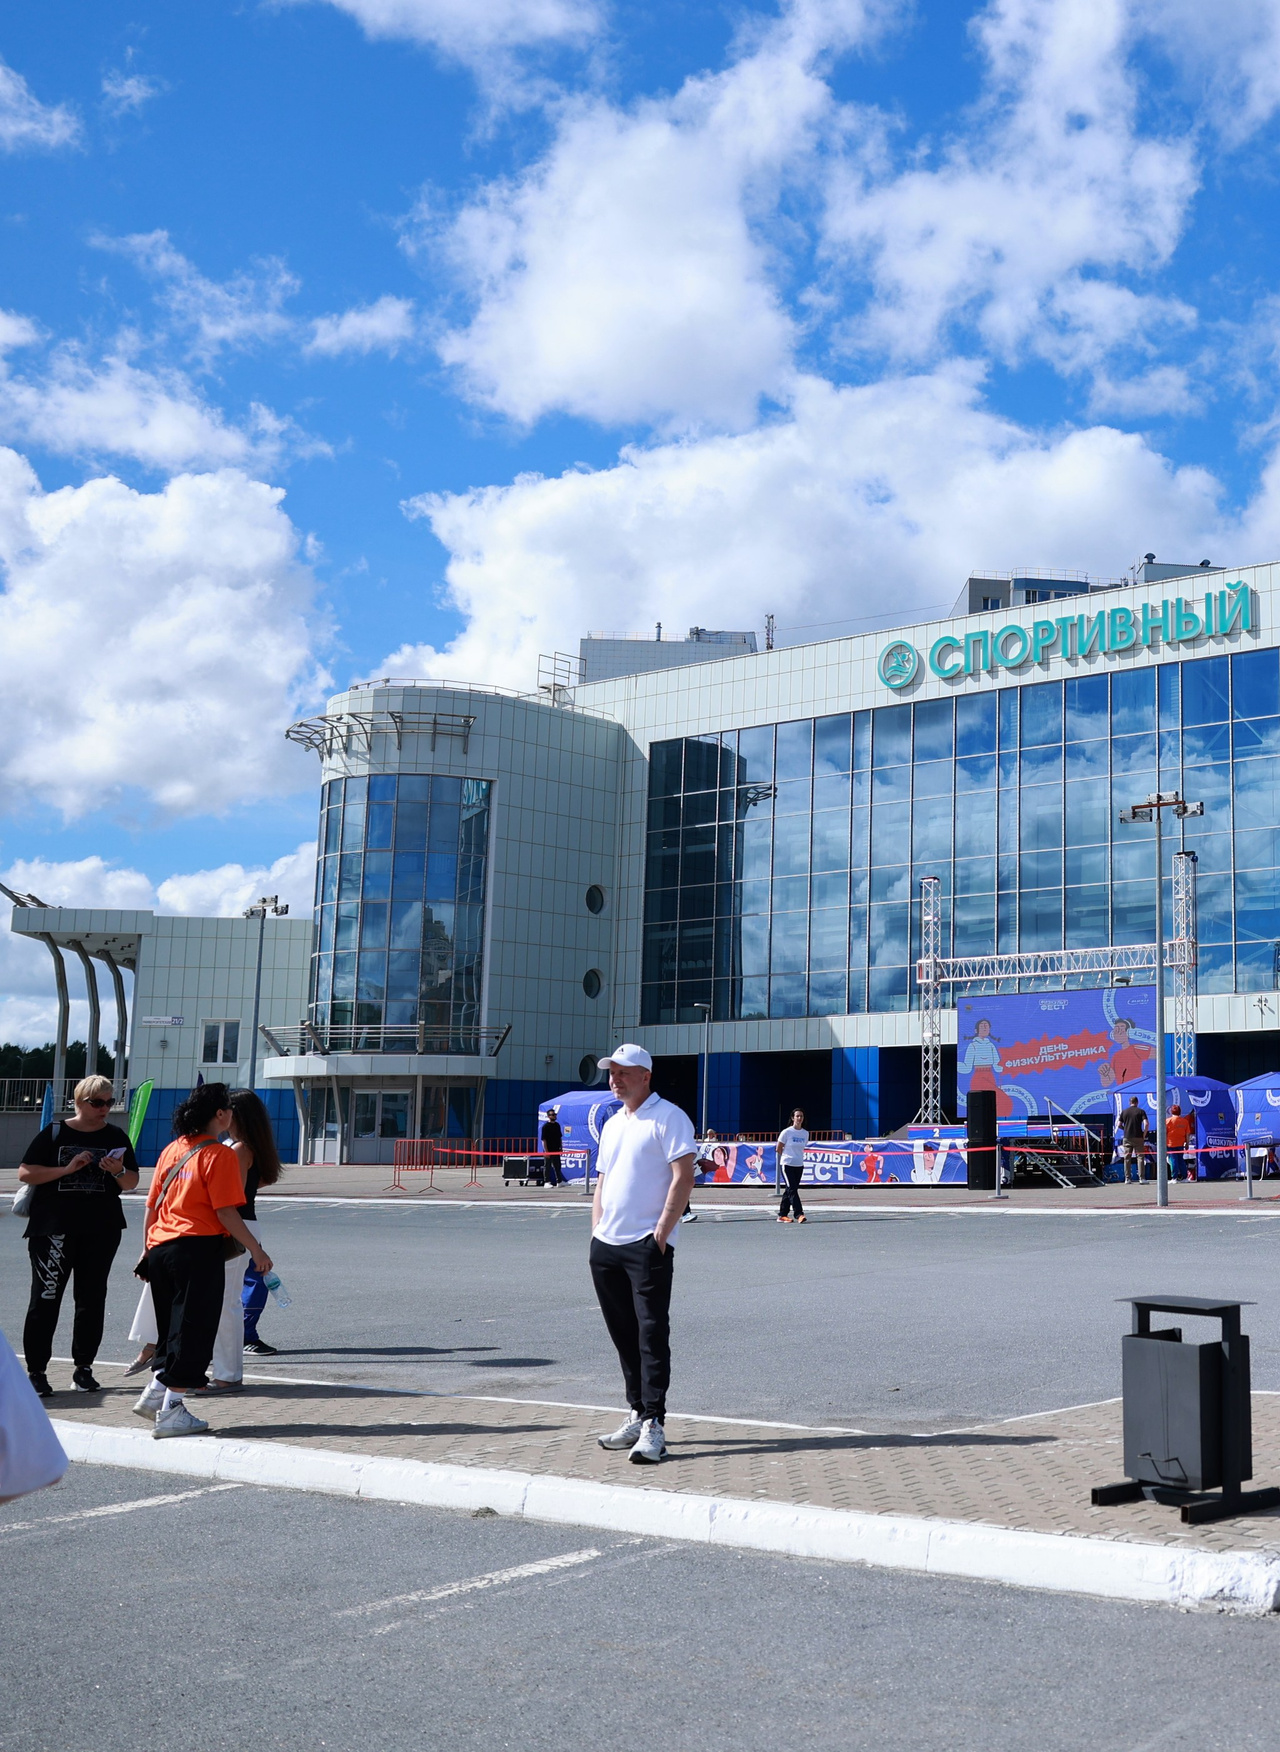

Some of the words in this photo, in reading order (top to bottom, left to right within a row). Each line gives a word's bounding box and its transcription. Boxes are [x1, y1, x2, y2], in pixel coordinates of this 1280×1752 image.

[929, 581, 1254, 678] СПОРТИВНЫЙ
[1039, 1043, 1069, 1055] ДЕНЬ
[1005, 1045, 1106, 1068] ФИЗКУЛЬТУРНИКА
[1087, 1093, 1105, 1103] ФЕСТ
[932, 1128, 940, 1137] 2
[1208, 1138, 1236, 1147] ФИЗКУЛЬТ
[803, 1150, 850, 1164] ЗКУЛЬТ
[1208, 1147, 1236, 1159] ФЕСТ
[561, 1158, 583, 1169] ЕСТ
[802, 1163, 845, 1181] ЕСТ
